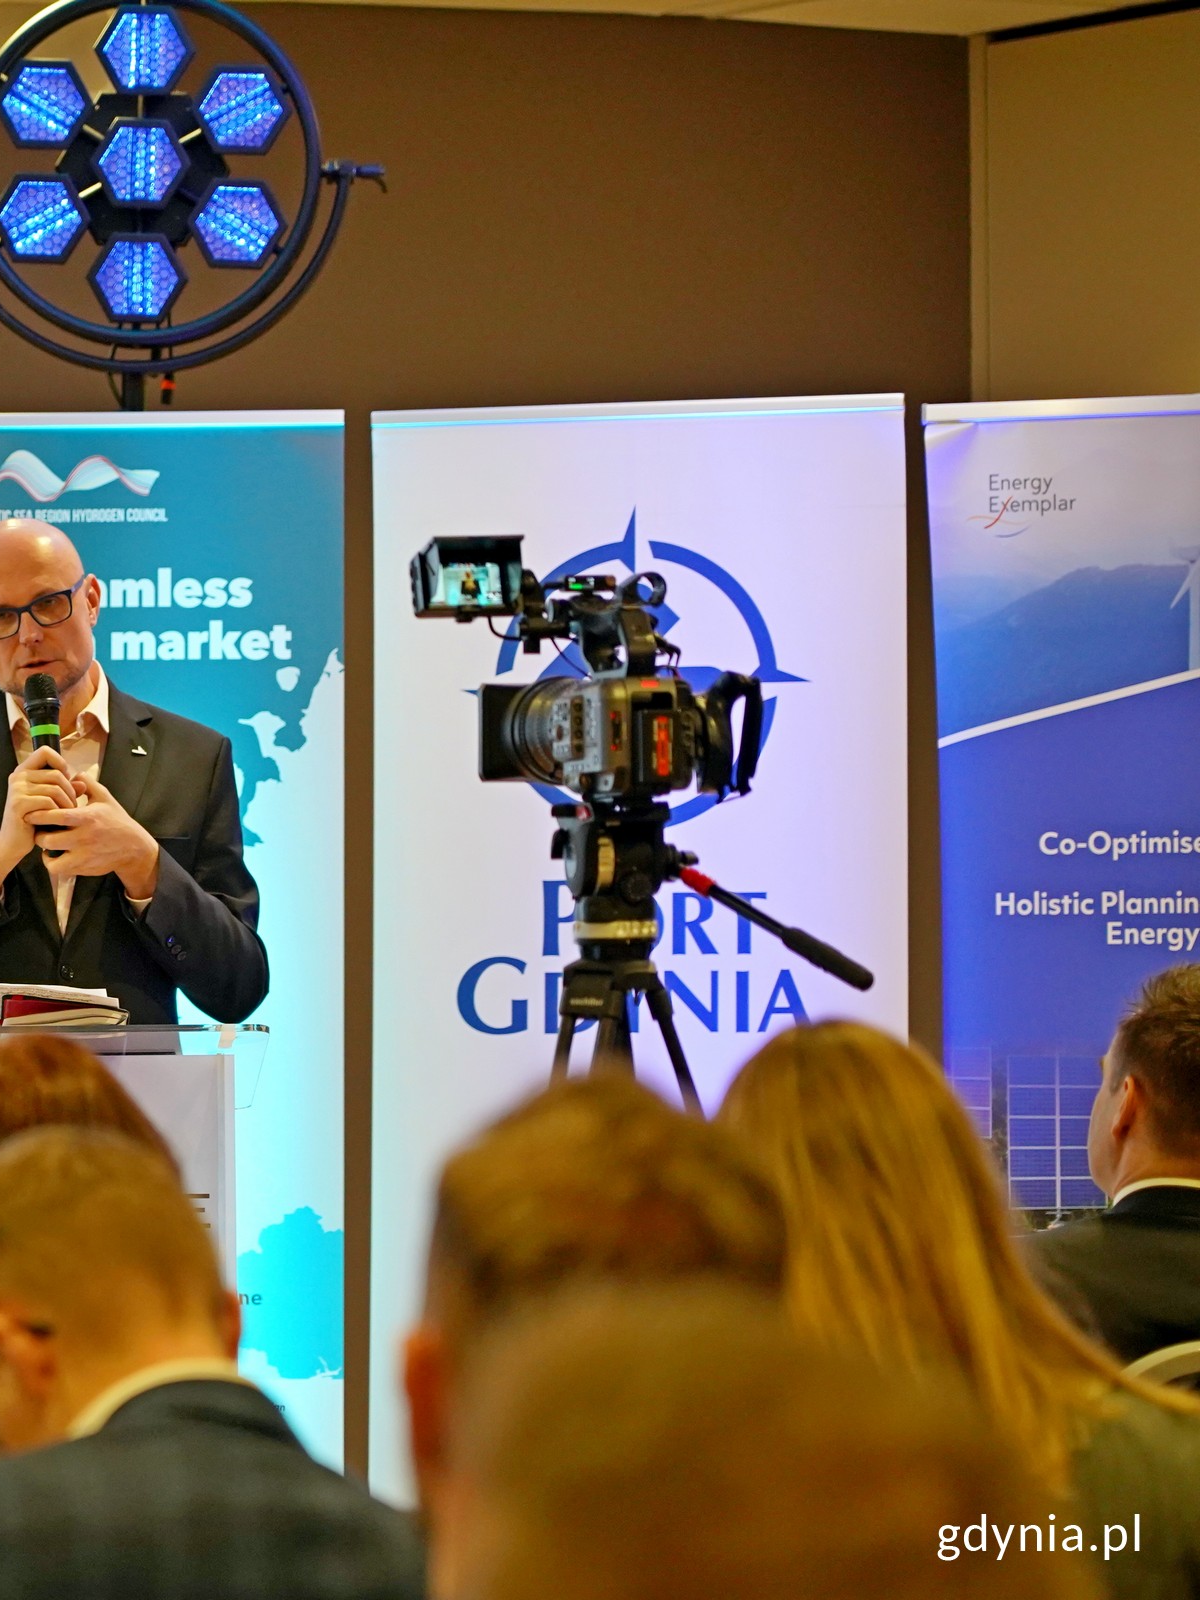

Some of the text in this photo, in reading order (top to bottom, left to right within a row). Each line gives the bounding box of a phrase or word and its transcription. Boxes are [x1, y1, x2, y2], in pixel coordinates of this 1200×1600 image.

[989, 473, 1053, 495] Energy
[72, 508, 125, 522] HYDROGEN
[126, 507, 168, 522] COUNCIL
[989, 493, 1077, 517] Exemplar
[110, 619, 293, 661] market
[995, 890, 1095, 916] Holistic
[542, 880, 767, 957] PRT
[1106, 921, 1200, 952] Energy
